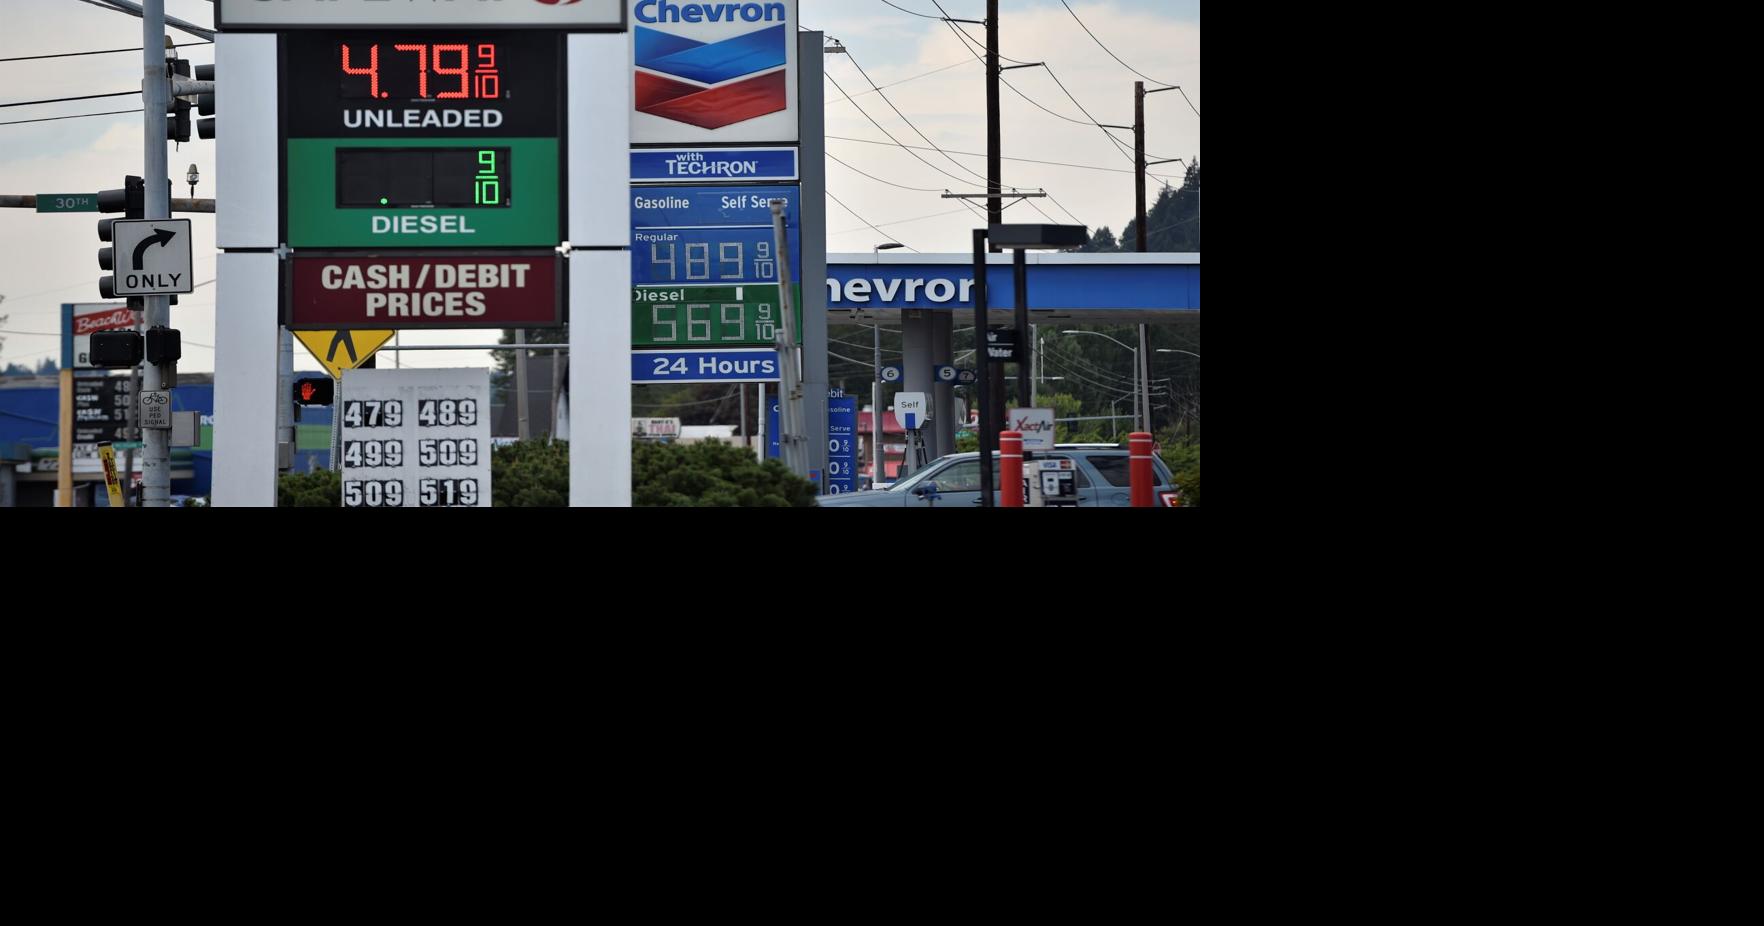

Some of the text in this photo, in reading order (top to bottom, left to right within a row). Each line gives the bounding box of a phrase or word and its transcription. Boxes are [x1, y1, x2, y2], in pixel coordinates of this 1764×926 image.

[634, 0, 786, 23] Chevron
[341, 44, 469, 98] 4.79
[343, 109, 503, 128] UNLEADED
[676, 152, 703, 161] with
[665, 160, 757, 177] TECHRON
[55, 198, 89, 209] 30TH
[634, 195, 788, 209] Gasoline Self Sere
[372, 215, 475, 233] DIESEL
[635, 233, 679, 243] Regular
[651, 242, 744, 280] 489
[126, 273, 182, 289] ONLY
[366, 292, 486, 317] PRICES
[652, 303, 745, 341] 569
[653, 357, 775, 375] 24 Hours
[886, 369, 895, 378] 6
[943, 369, 951, 377] 5
[344, 399, 477, 427] 479 489
[901, 401, 919, 409] Self
[344, 439, 478, 467] 499 509
[344, 479, 478, 507] 509 519
